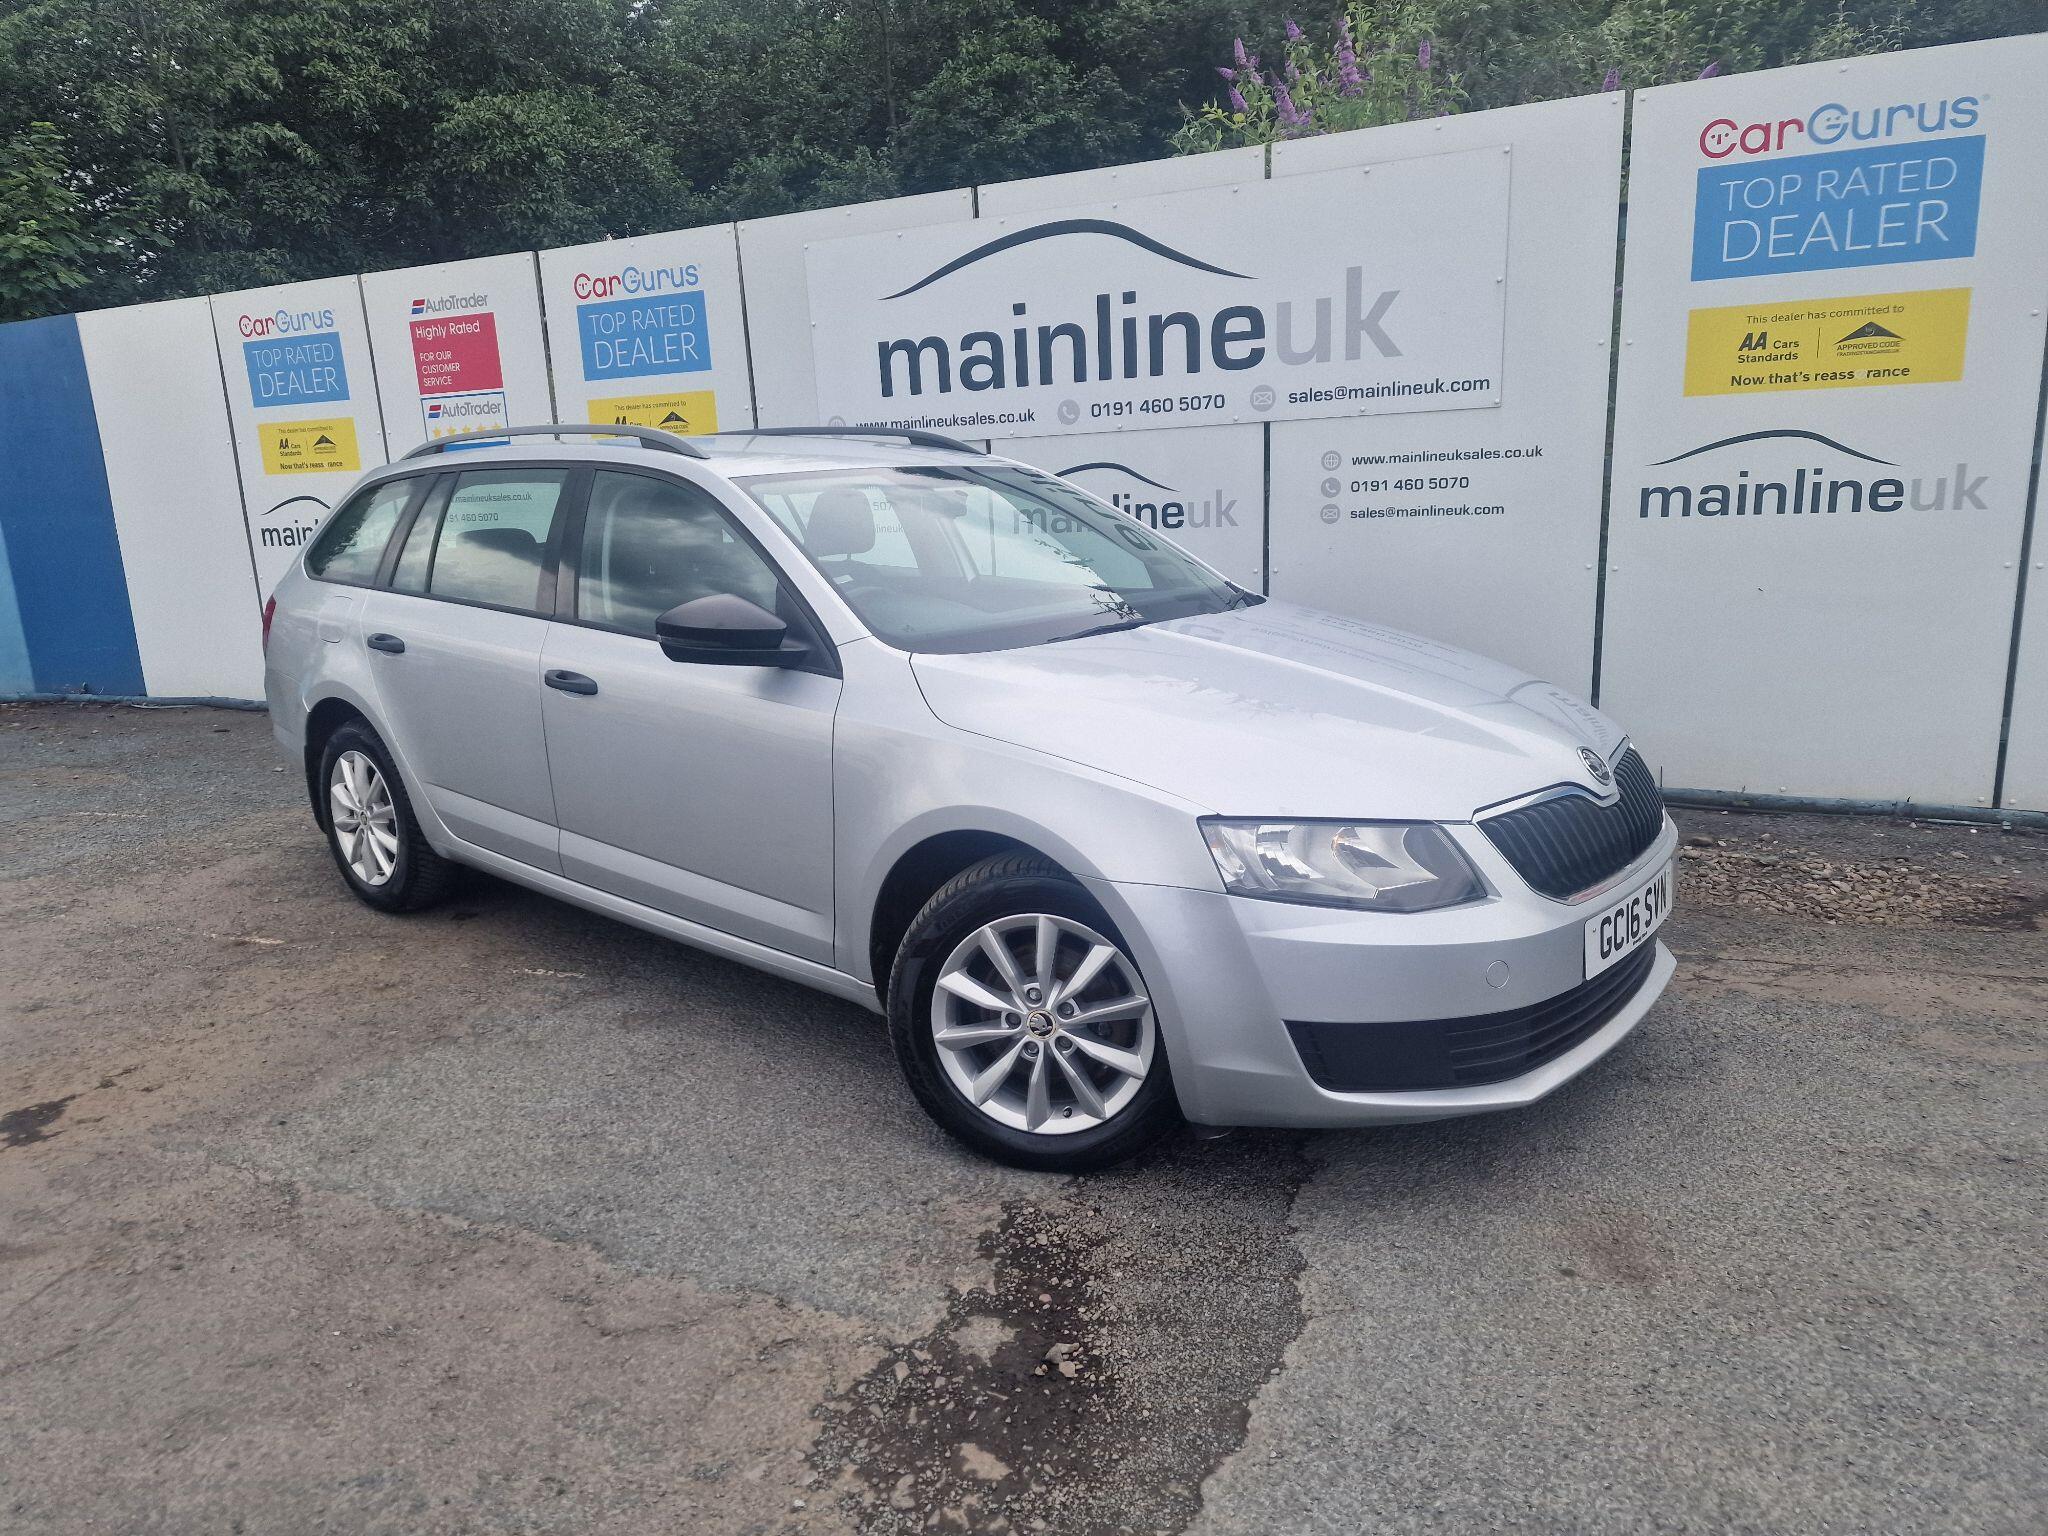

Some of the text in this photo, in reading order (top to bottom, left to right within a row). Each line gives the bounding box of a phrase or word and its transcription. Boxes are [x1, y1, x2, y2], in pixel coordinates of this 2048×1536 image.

[1699, 96, 1980, 159] CarGurus
[1719, 157, 1958, 212] TOP RATED
[1722, 199, 1950, 263] DEALER
[573, 264, 699, 300] CarGurus
[425, 293, 488, 313] AutoTrader
[239, 310, 335, 338] CarGurus
[588, 304, 696, 335] TOP RATED
[1747, 305, 1905, 324] This dealer has committed to
[415, 320, 481, 340] Highly Rated
[877, 265, 1403, 398] mainlineuk
[594, 331, 699, 369] DEALER
[1737, 331, 1800, 351] AA Cars
[252, 343, 335, 369] TOP RATED
[420, 351, 452, 362] FOR OUR
[1737, 351, 1799, 364] Standards
[421, 362, 461, 375] CUSTOMER
[1730, 367, 1911, 387] Now that's reassrance
[259, 366, 340, 398] DEALER
[423, 375, 453, 387] SERVICE
[441, 400, 501, 418] AutoTrader
[855, 376, 1491, 430] wwwmainlineuksales.co.uk 0191 460 5070 sales@mainlineuk.com
[279, 437, 290, 450] AA
[1351, 445, 1544, 466] www.mainlineuksales.co.uk
[1350, 476, 1470, 493] 0191 460 5070
[1639, 462, 1990, 518] mainlineuk
[1350, 504, 1505, 519] sales@mainlineuk.com
[1600, 869, 1667, 960] GC16 SVN
